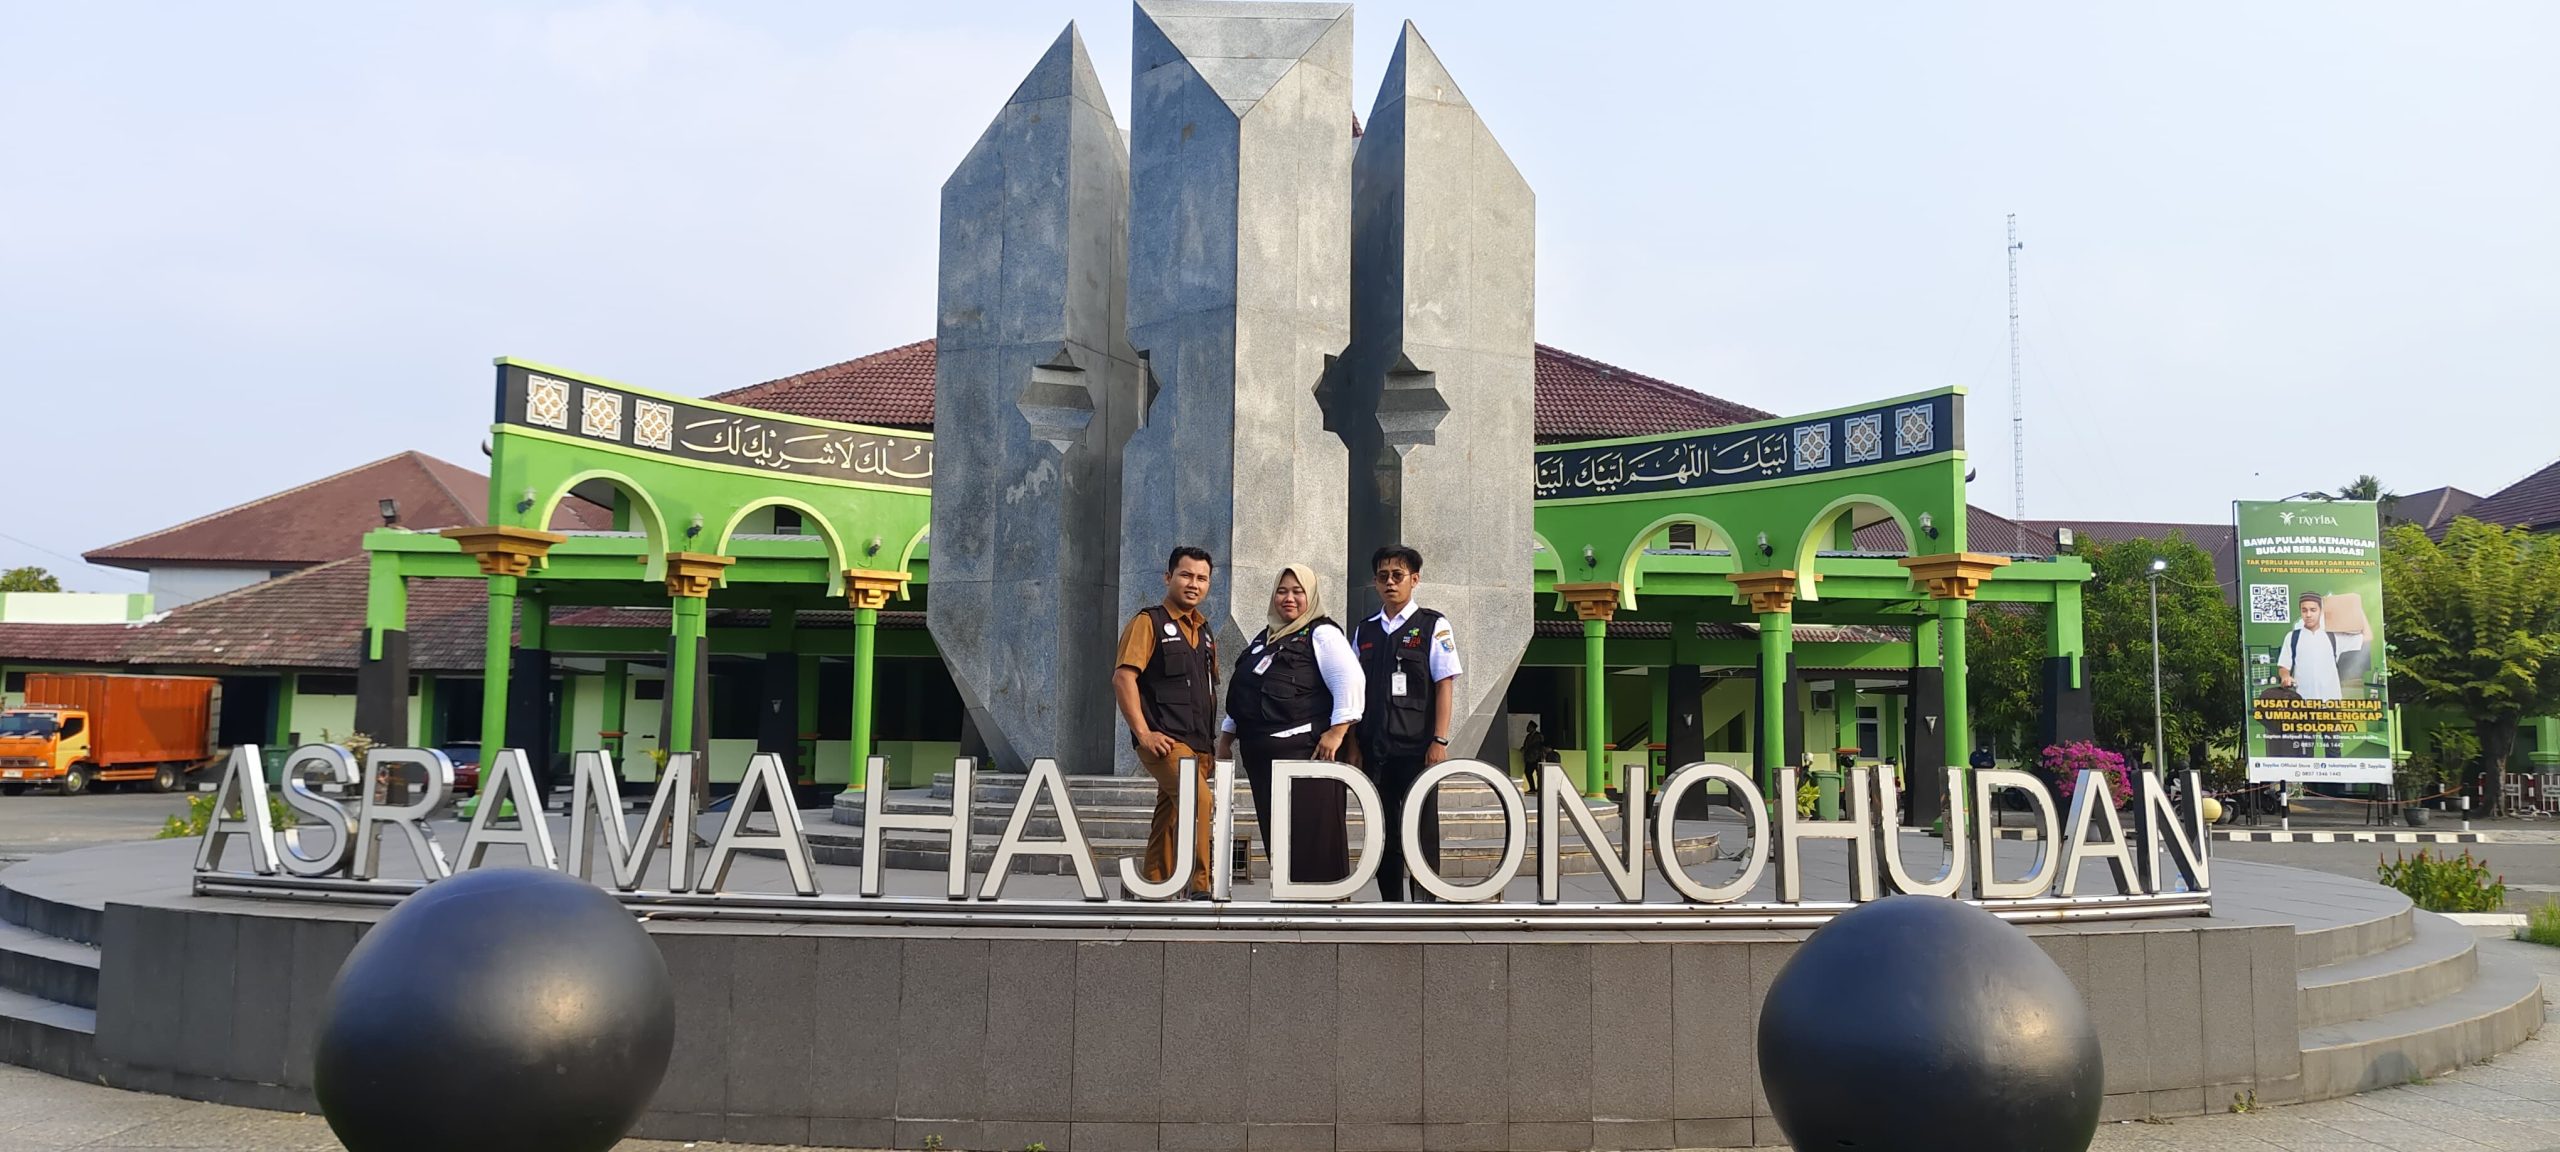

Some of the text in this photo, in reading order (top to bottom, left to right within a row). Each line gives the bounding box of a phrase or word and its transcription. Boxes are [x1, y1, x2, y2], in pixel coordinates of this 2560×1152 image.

[2243, 536, 2376, 549] BAWA PULANG KENANGAN
[2256, 545, 2364, 557] BUKAN BEBAN BAGASI
[2253, 700, 2382, 710] PUSAT OLEH-OLEH HAJI
[2253, 711, 2383, 721] & UMRAH TERLENGKAP
[2282, 723, 2356, 733] DI SOLORAYA
[194, 744, 2211, 905] ASRAMA HAJI DONOHUDAN
